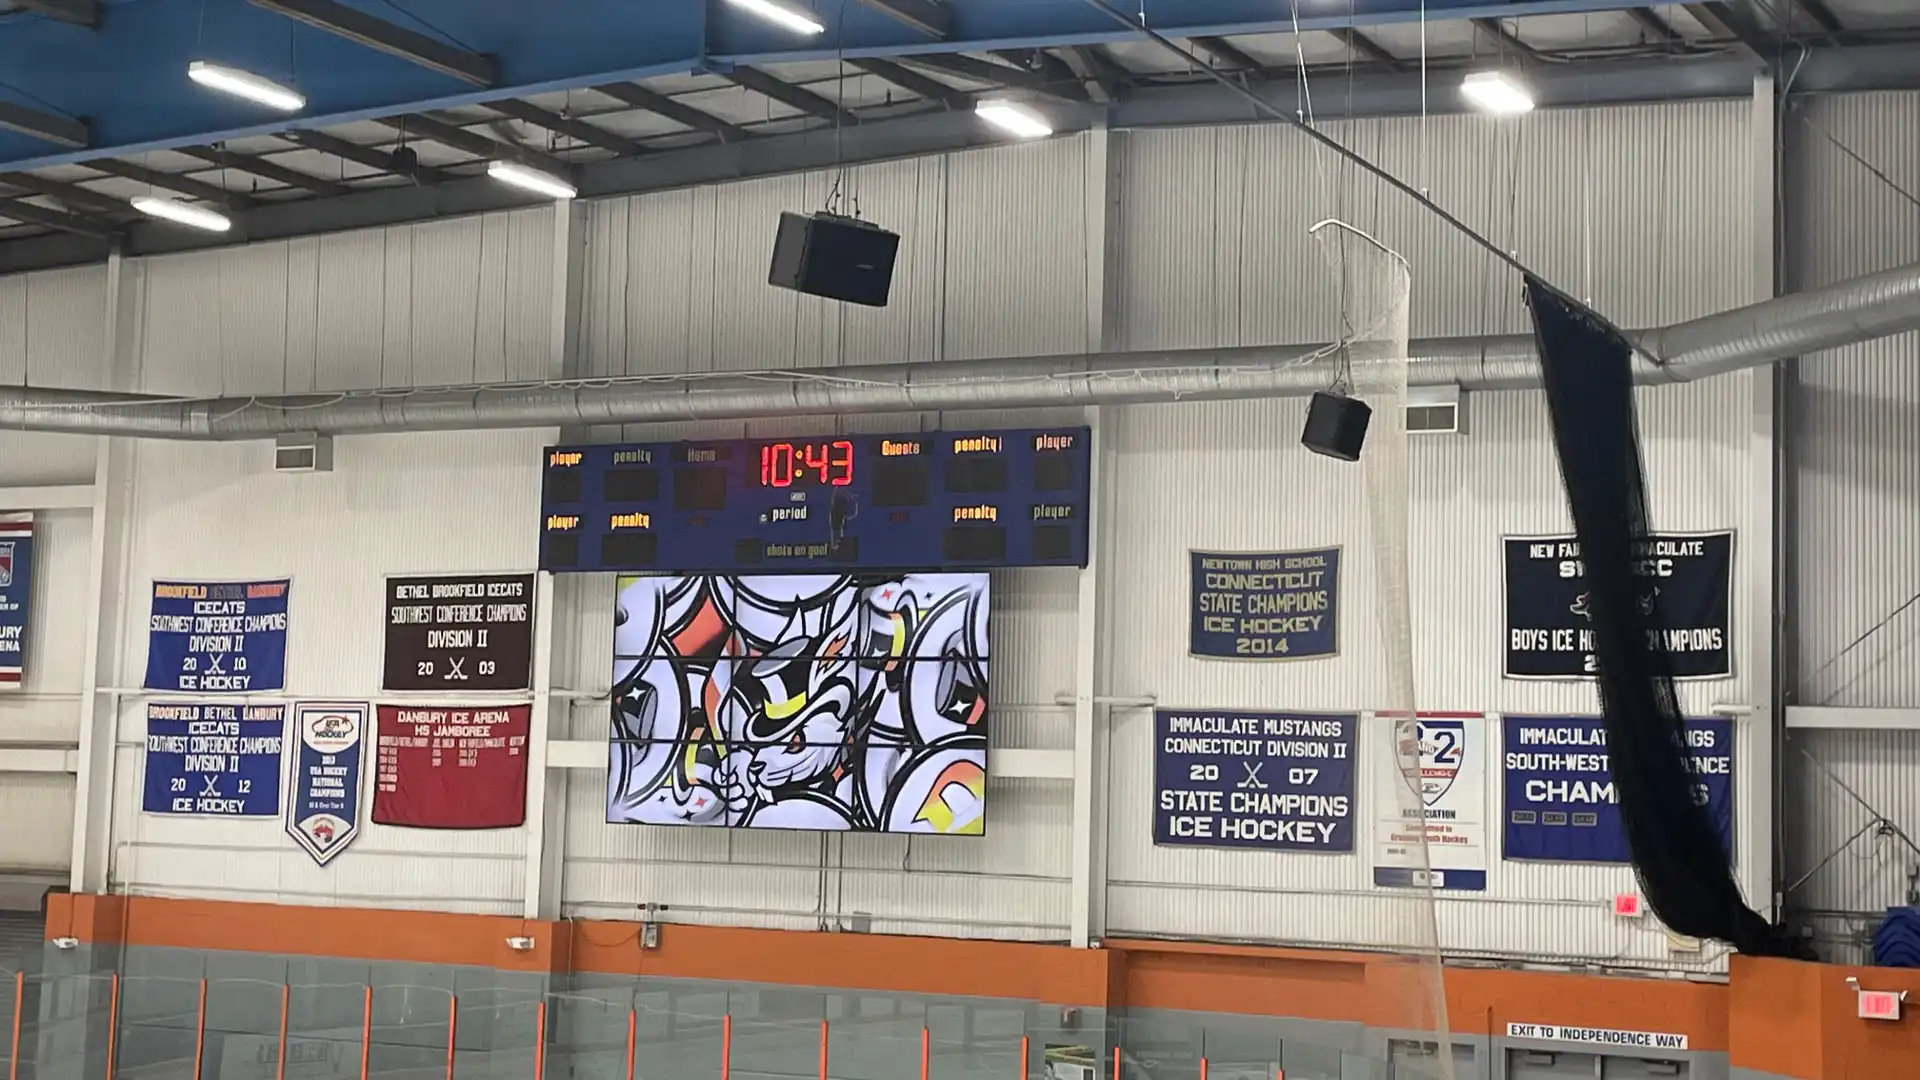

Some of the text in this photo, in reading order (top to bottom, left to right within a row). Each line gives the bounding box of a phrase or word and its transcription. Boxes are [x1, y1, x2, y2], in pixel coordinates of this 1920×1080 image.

[882, 440, 920, 456] Guests
[954, 436, 997, 454] penalty
[1036, 434, 1073, 451] player
[550, 450, 582, 467] player
[613, 449, 651, 465] penalty
[762, 441, 852, 487] 10:43
[772, 506, 806, 522] period
[954, 505, 997, 522] penalty
[1034, 504, 1071, 519] player
[548, 514, 579, 530] player
[611, 512, 649, 530] penalty
[1530, 544, 1554, 558] NEW
[1202, 556, 1327, 570] NEWTOWN HIGH SCHOOL
[1206, 572, 1324, 589] CONNECTICUT
[396, 583, 523, 598] BETHEL BROOKFIELD ICECATS
[194, 601, 245, 614] ICECATS
[1200, 591, 1327, 614] STATE CHAMPIONS
[392, 604, 526, 623] SOUTHWEST CONFERENCE CHAMPIONS
[151, 613, 286, 633] SOUTHWEST CONFERENCE CHAMPIONS
[1204, 615, 1323, 633] ICE HOCKEY
[190, 636, 244, 652] DIVISION II
[428, 630, 487, 648] DIVISION II
[1236, 638, 1289, 653] 2014
[1512, 628, 1547, 650] BOYS
[1552, 629, 1574, 651] ICE
[183, 657, 246, 670] 20 10
[418, 662, 495, 675] 20 03
[180, 676, 250, 689] ICE HOCKEY
[149, 706, 199, 720] BROOKFIELD
[204, 706, 236, 720] BETHEL
[398, 711, 509, 724] DANBURY ICE ARENA
[188, 722, 239, 734] ICECATS
[415, 725, 490, 737] HS JAMBOREE
[1170, 717, 1341, 736] IMMACULATE MUSTANGS
[149, 735, 281, 754] SOUTHWEST CONFERENCE CHAMPIONS
[1520, 728, 1608, 745] IMMACULAT
[1165, 738, 1346, 758] CONNECTICUT DIVISION II
[185, 755, 238, 772] DIVISION II
[1506, 753, 1609, 771] SOUTH-WEST
[1190, 764, 1319, 784] 20 07
[171, 779, 251, 792] 20 12
[173, 798, 245, 812] ICE HOCKEY
[1160, 790, 1348, 817] STATE CHAMPIONS
[1170, 815, 1336, 844] ICE HOCKEY
[1511, 1025, 1684, 1048] EXIT TO INDEPENDENCE WAY
